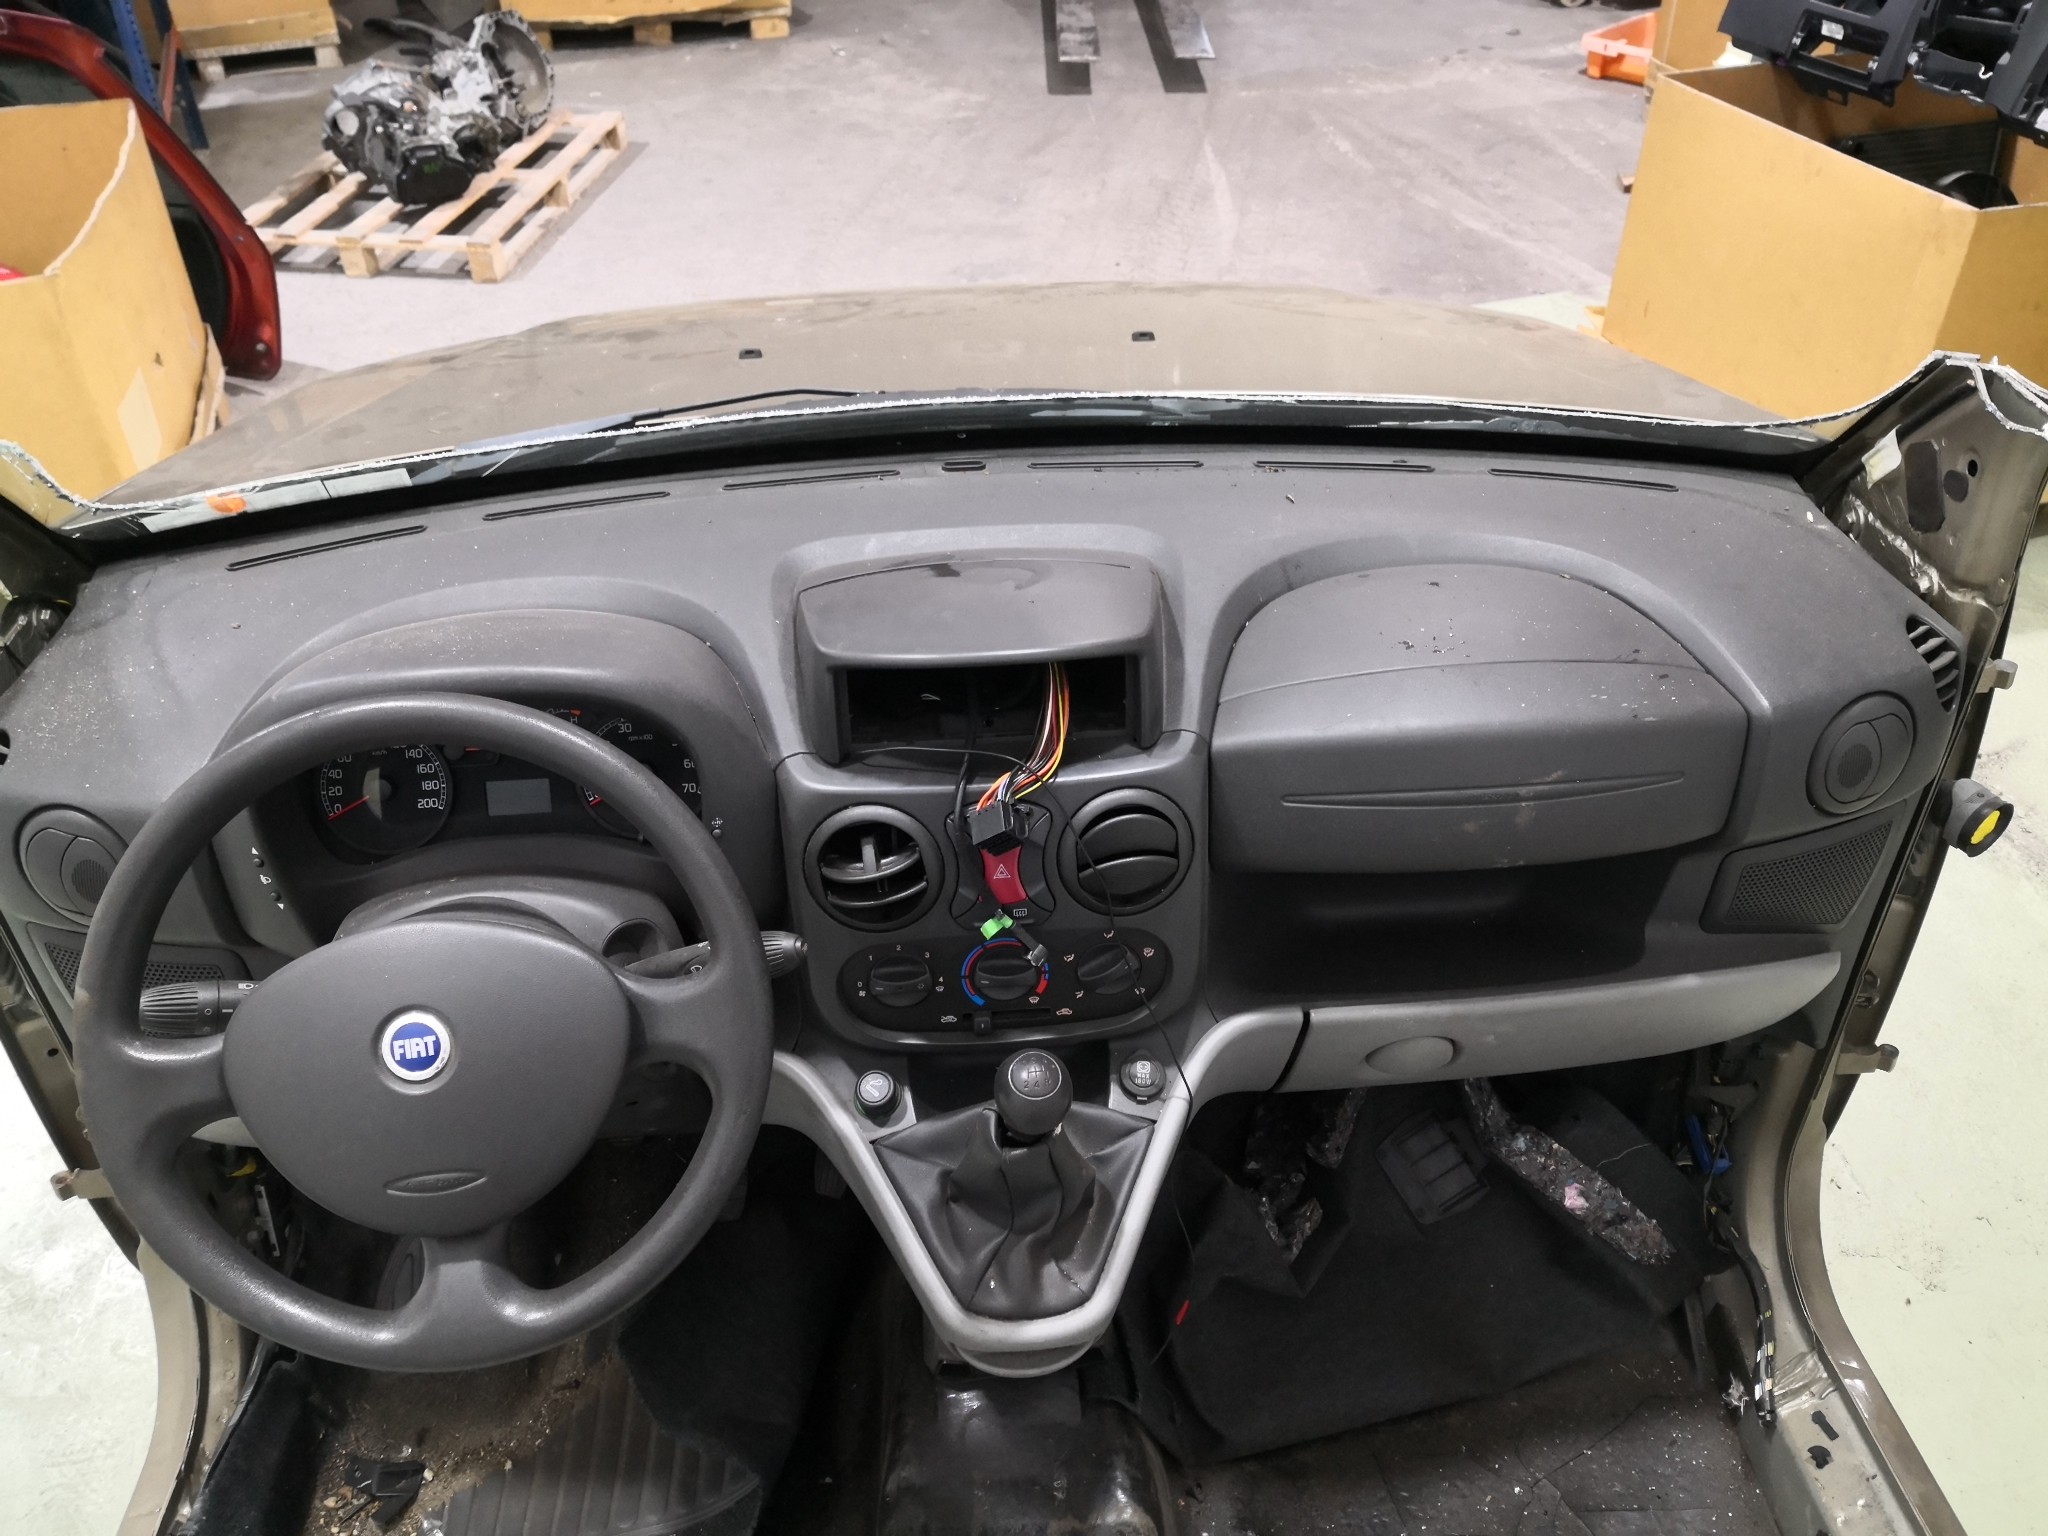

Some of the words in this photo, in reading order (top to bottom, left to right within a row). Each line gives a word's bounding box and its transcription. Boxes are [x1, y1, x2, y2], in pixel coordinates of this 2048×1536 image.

[570, 716, 578, 724] H
[617, 723, 632, 733] 30
[405, 749, 423, 759] 140
[416, 763, 435, 773] 160
[328, 769, 343, 779] 40
[421, 780, 440, 790] 180
[682, 783, 697, 793] 70
[328, 786, 343, 797] 20
[334, 804, 342, 813] 0
[417, 798, 439, 809] 200
[924, 951, 930, 959] 3
[392, 1035, 437, 1061] FIAT
[1023, 1080, 1030, 1089] 2
